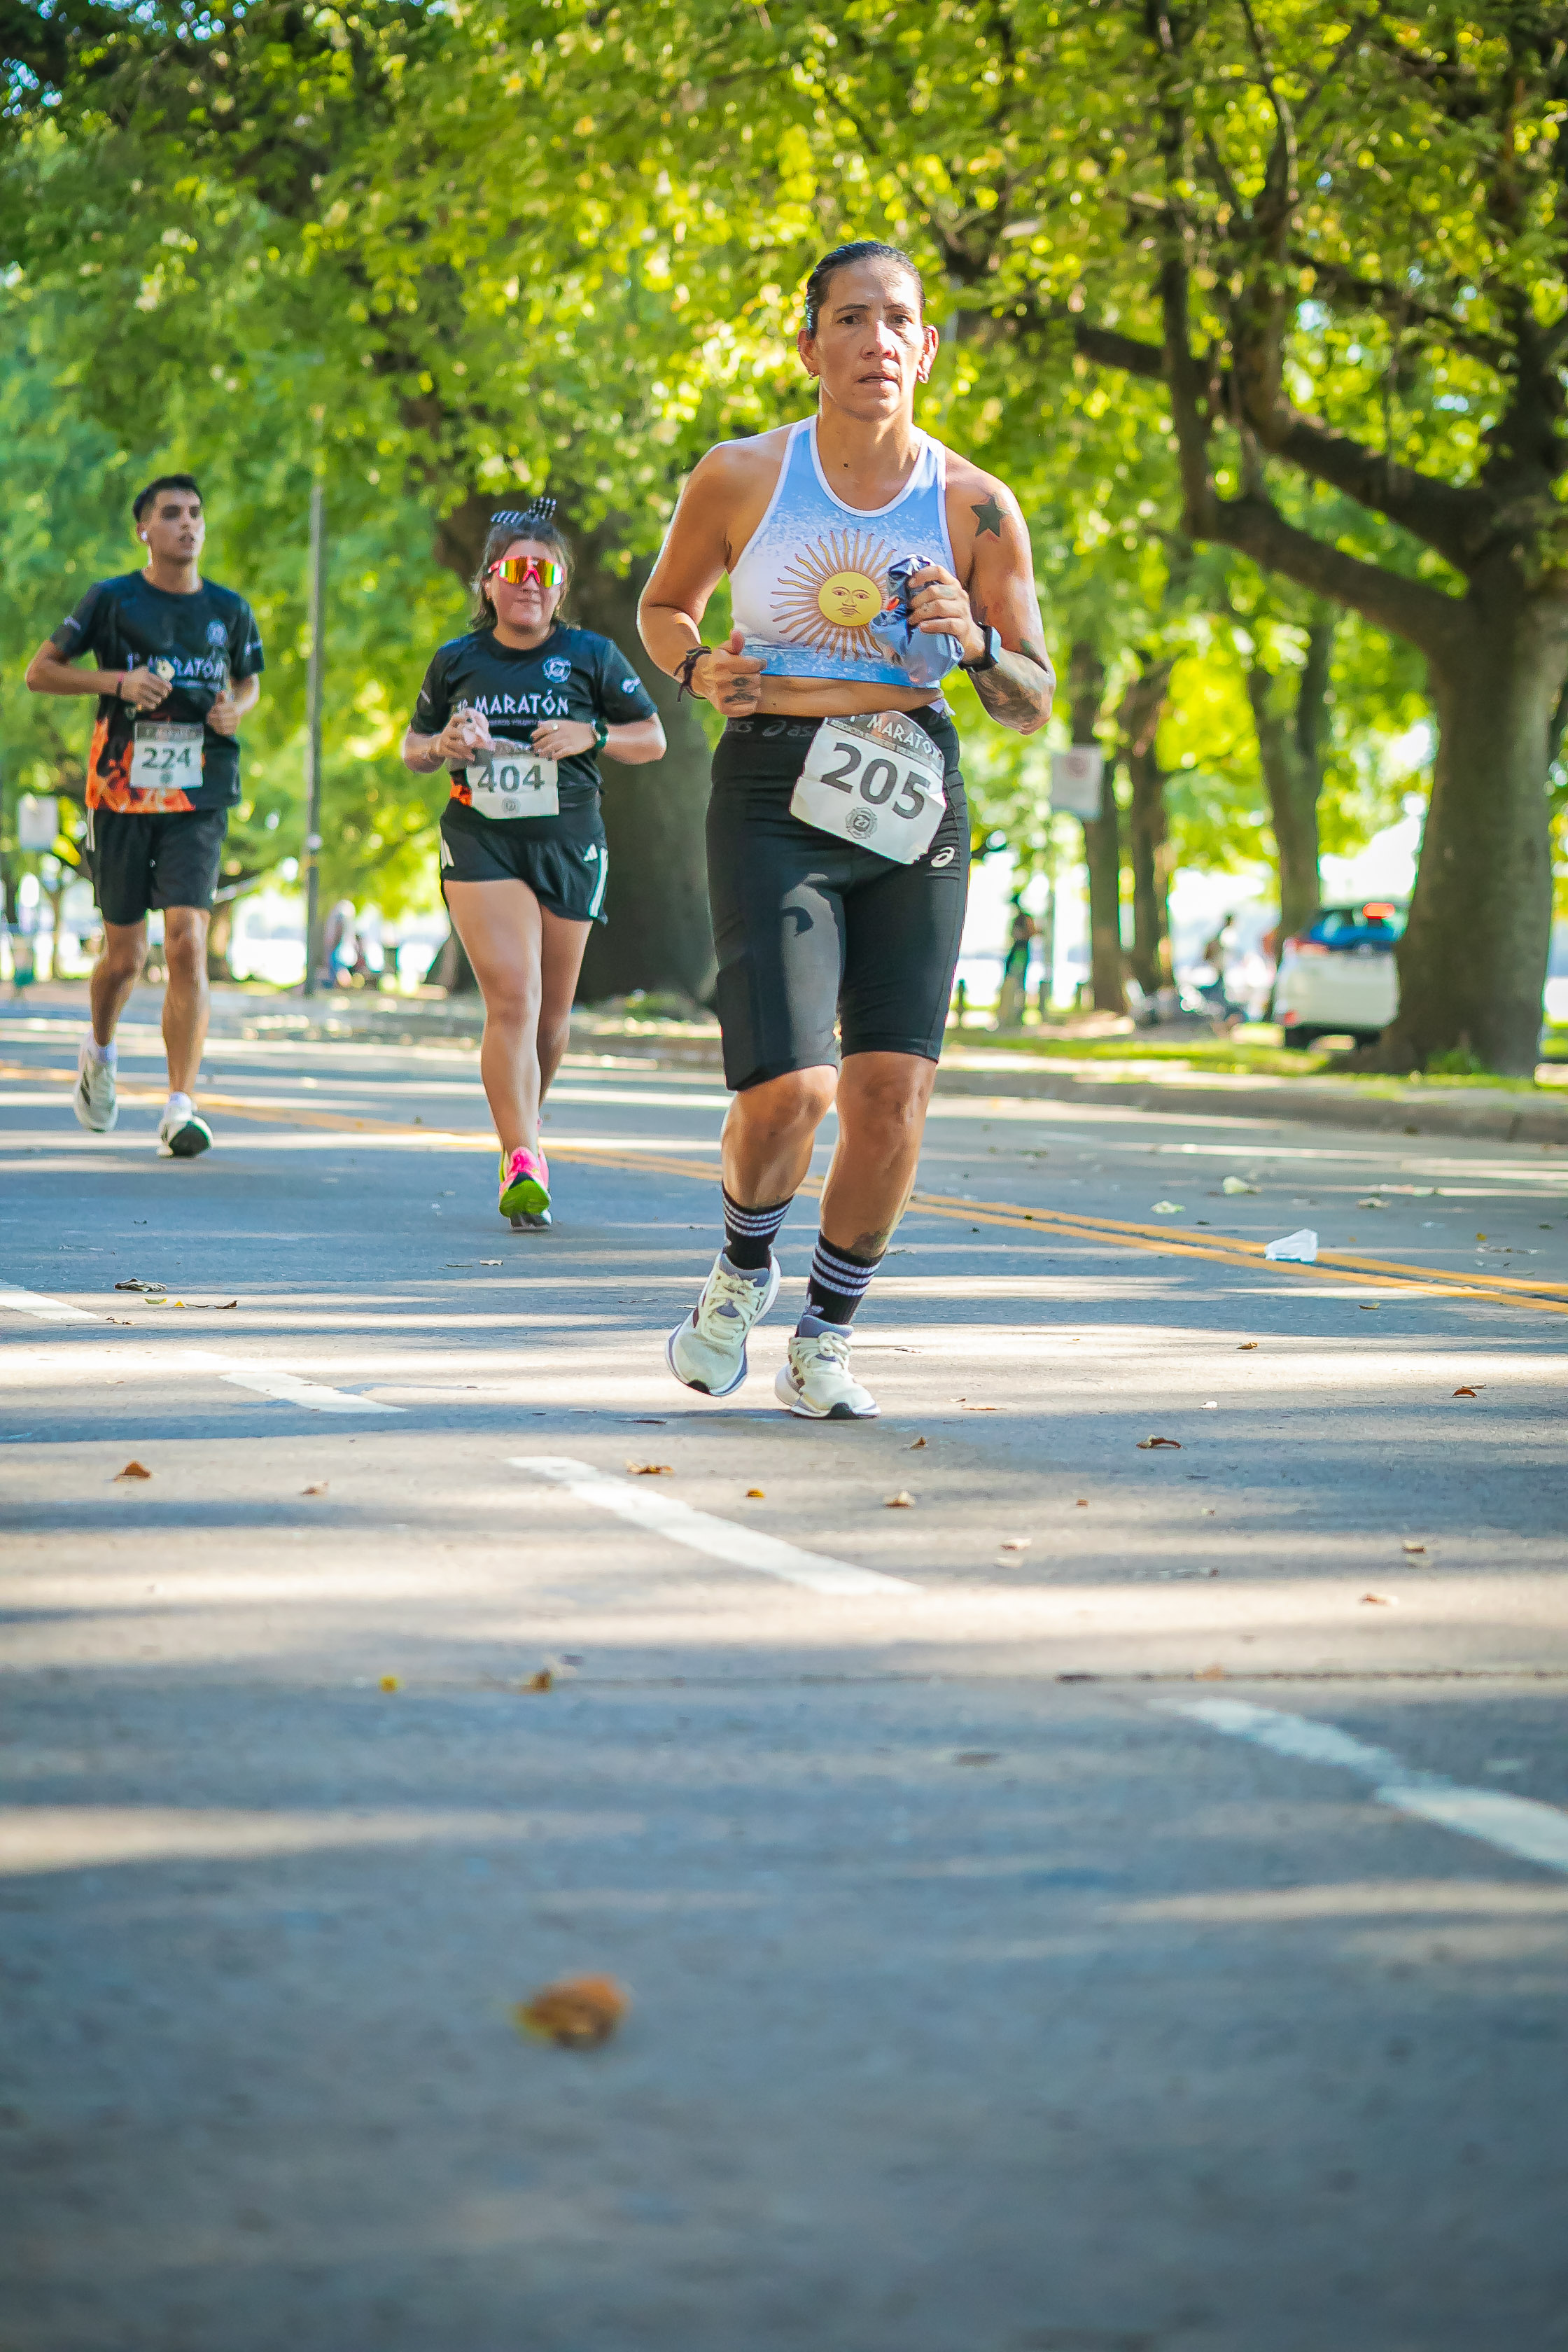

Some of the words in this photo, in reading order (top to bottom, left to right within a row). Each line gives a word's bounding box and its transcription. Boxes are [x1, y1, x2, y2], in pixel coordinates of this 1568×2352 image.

[475, 688, 569, 715] MARATÓN
[142, 746, 191, 769] 224
[477, 764, 545, 792] 404
[820, 741, 931, 820] 205
